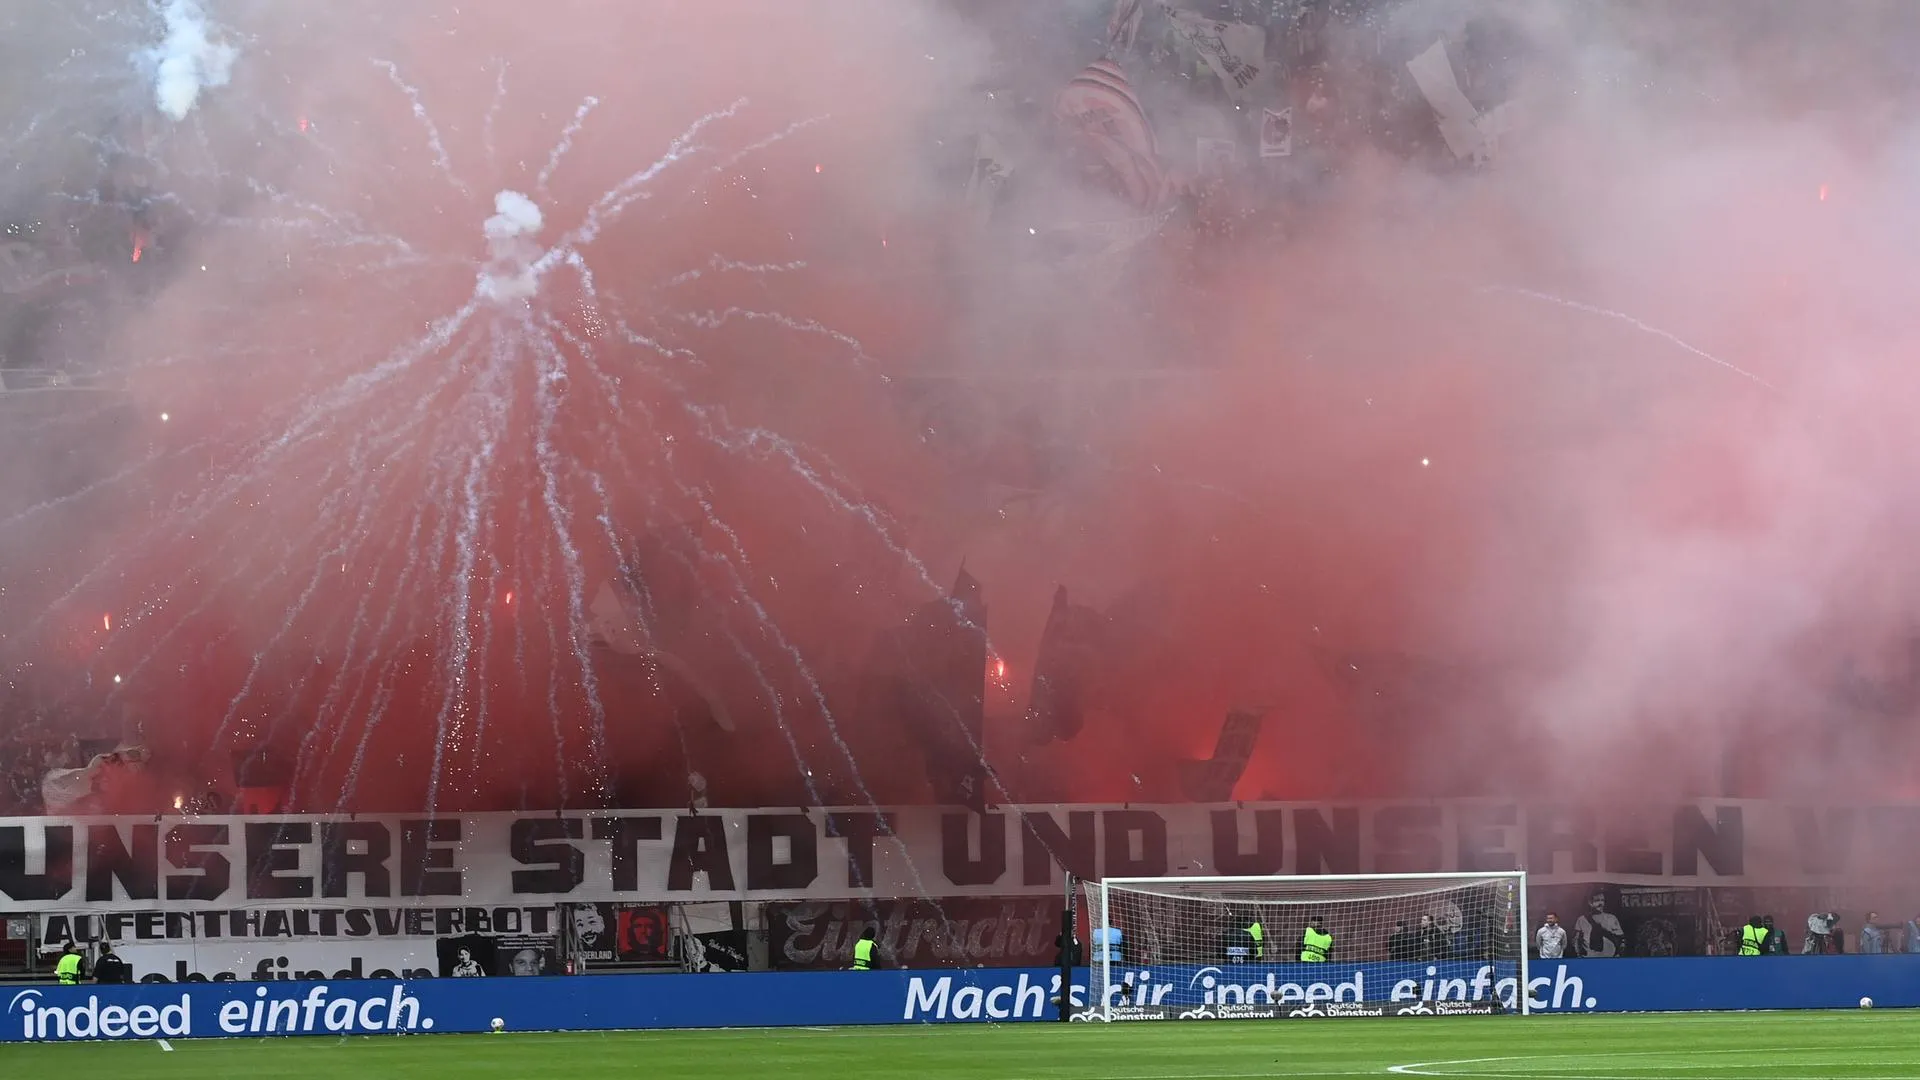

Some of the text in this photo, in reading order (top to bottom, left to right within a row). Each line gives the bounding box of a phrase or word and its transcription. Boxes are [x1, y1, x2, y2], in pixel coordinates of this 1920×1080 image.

[0, 819, 462, 901] UNSERE
[510, 812, 896, 893] STADT
[941, 809, 1167, 886] UND
[1213, 806, 1744, 879] UNSEREN
[44, 905, 553, 945] AUFENTHALTSVERBOT
[12, 985, 434, 1038] indeed einfach.
[1195, 970, 1364, 1005] indeed
[1391, 964, 1598, 1011] einfach.
